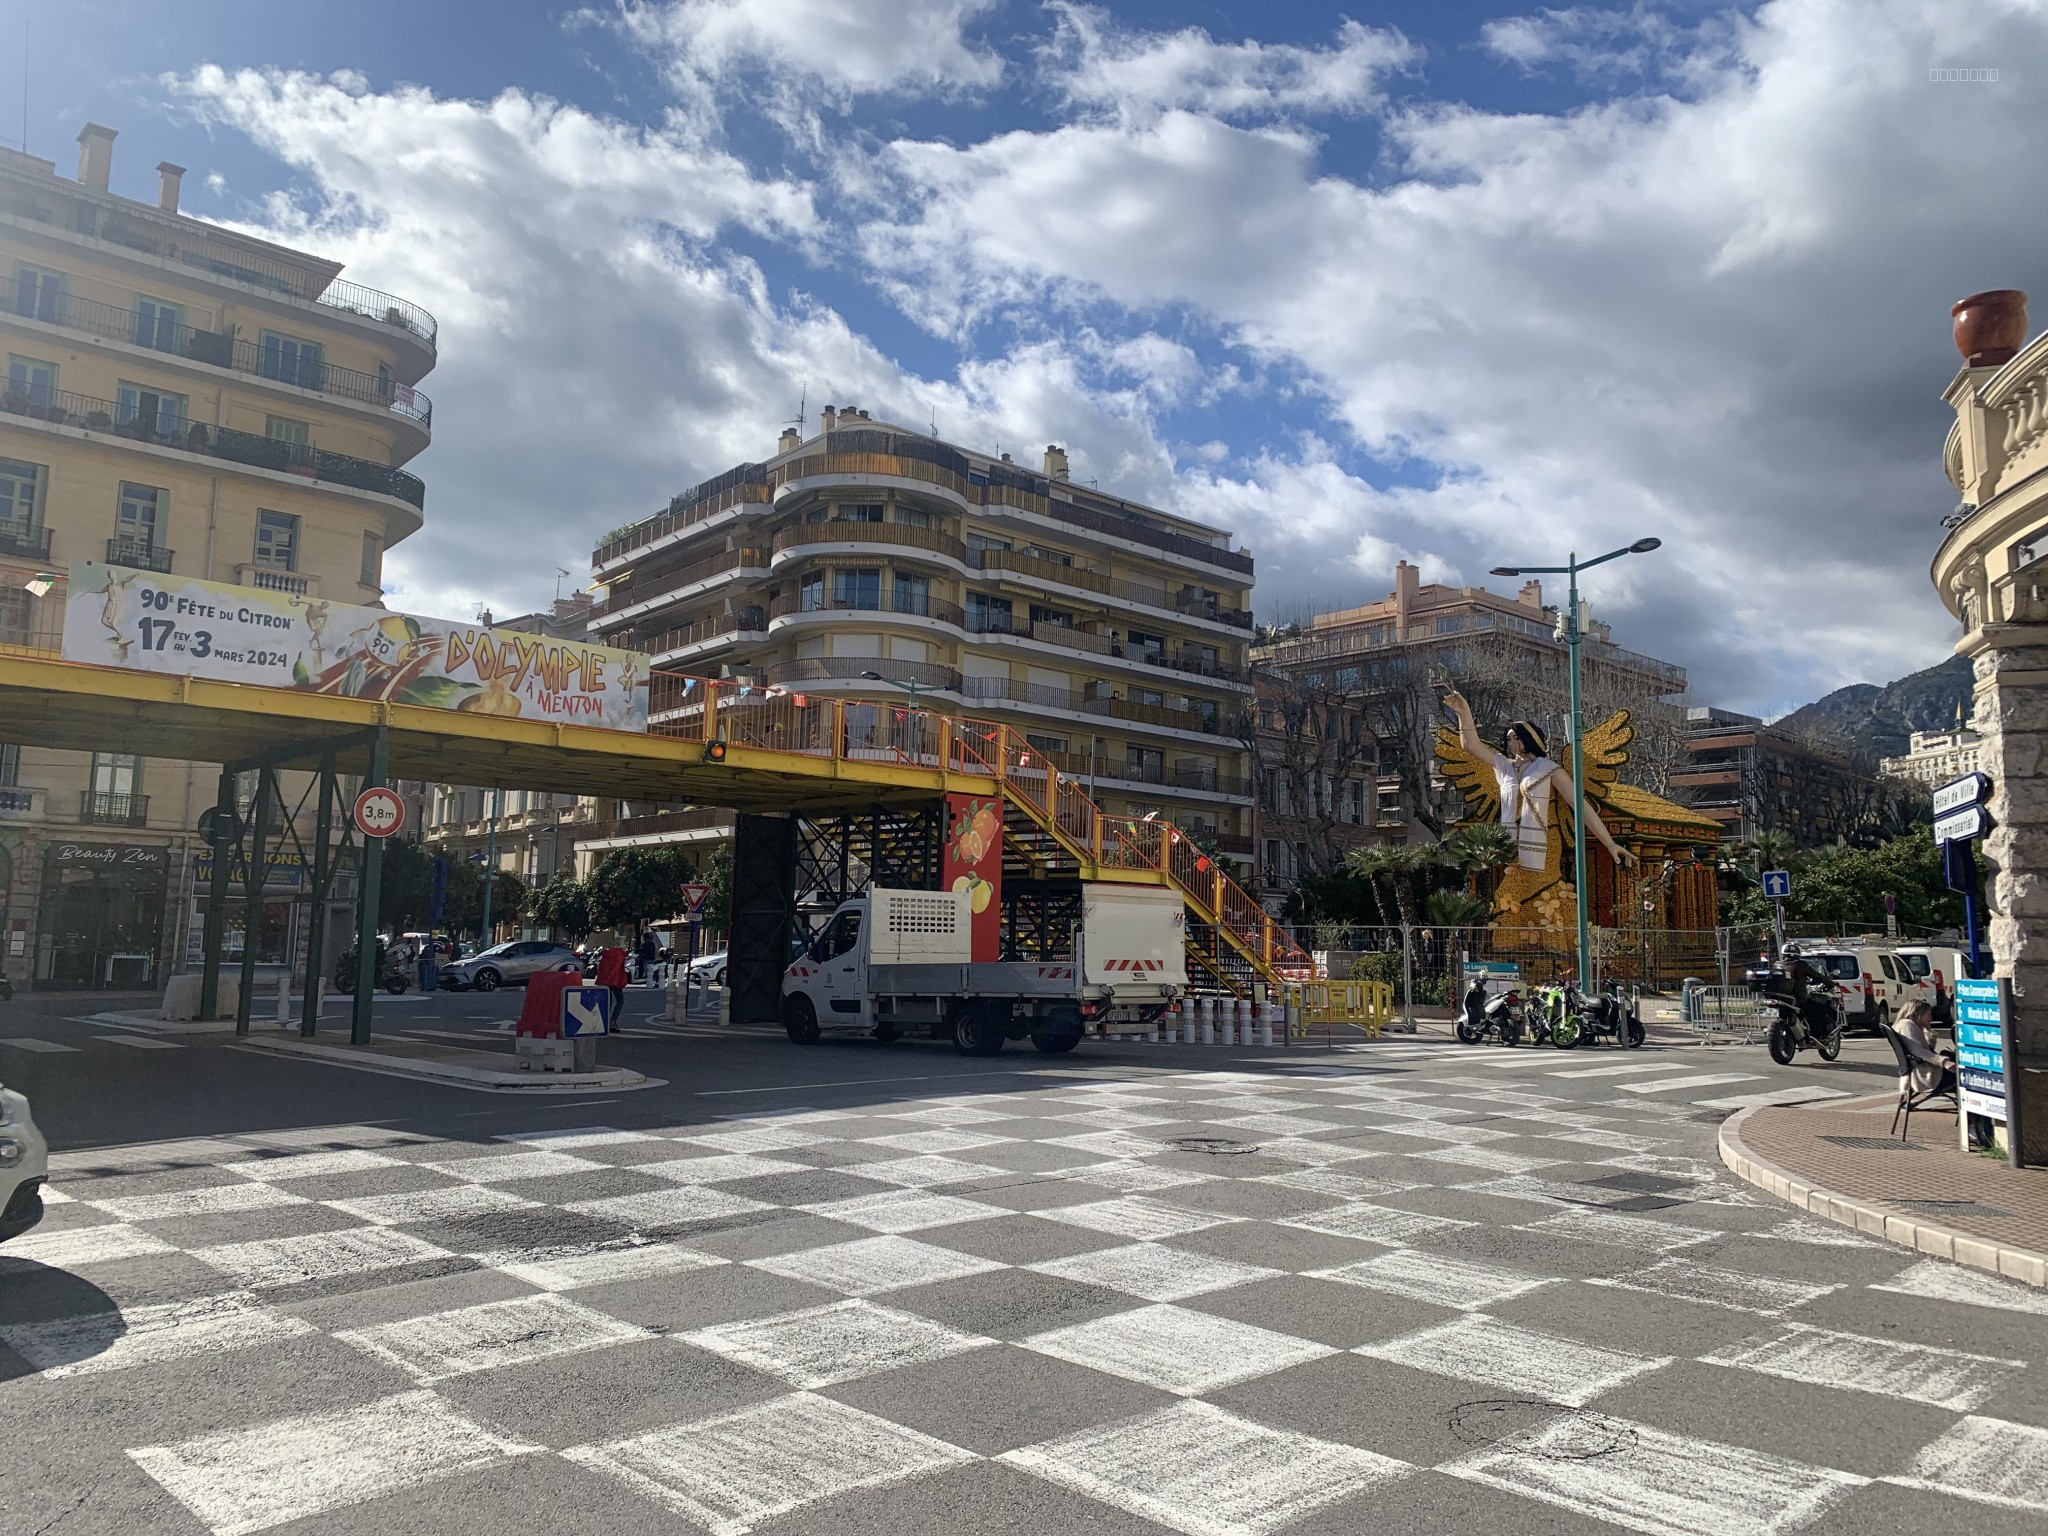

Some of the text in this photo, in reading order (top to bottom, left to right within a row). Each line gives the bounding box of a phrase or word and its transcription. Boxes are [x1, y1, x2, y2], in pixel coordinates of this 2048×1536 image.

[177, 598, 214, 618] FÊTE
[219, 610, 234, 621] DU
[138, 616, 176, 651] 17
[190, 631, 213, 658] 3
[173, 643, 186, 652] AU
[373, 637, 389, 654] 90
[214, 649, 287, 667] MARS 2024
[445, 630, 606, 695] D'OLYMPIE
[526, 676, 534, 700] À
[537, 690, 603, 717] MENTON
[57, 844, 158, 863] Beauty Zen
